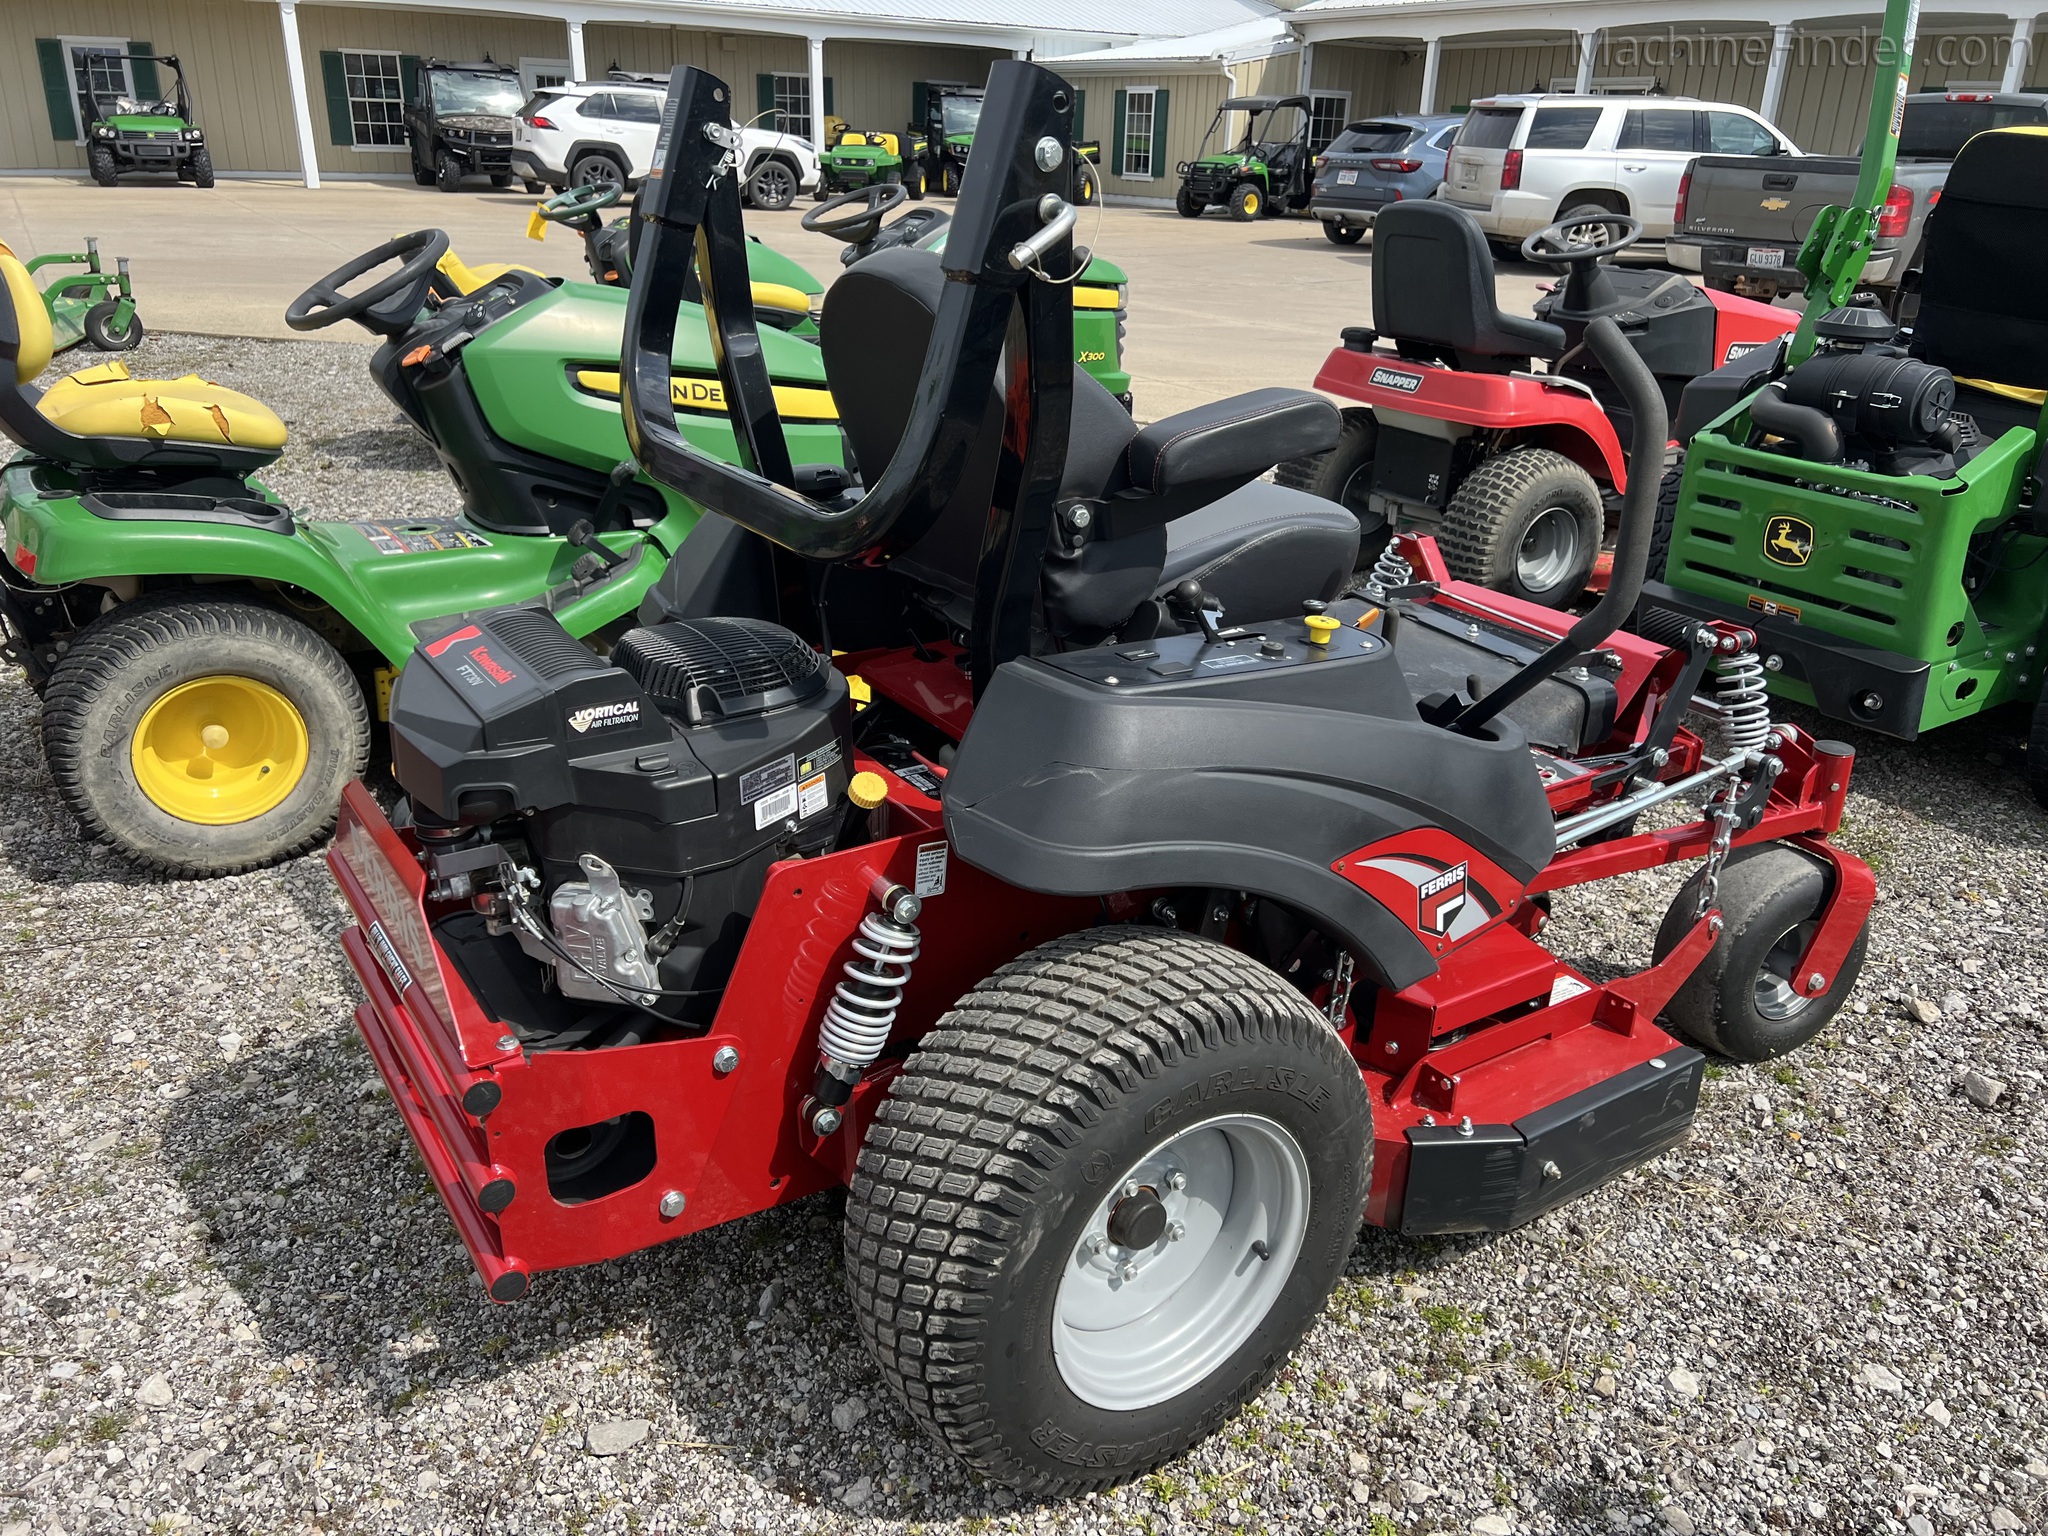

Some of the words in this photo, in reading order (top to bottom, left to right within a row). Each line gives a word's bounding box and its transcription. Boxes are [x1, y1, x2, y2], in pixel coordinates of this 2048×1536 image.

[1689, 225, 1735, 234] SILVERADO
[1764, 254, 1782, 266] 9378
[1078, 351, 1105, 363] X300
[1373, 370, 1418, 390] SNAPPER
[456, 664, 484, 686] FT730V
[469, 645, 517, 685] Kawasaki
[101, 664, 171, 759] CARLISLE
[575, 701, 639, 722] VORTICAL
[591, 720, 602, 728] AIR
[603, 714, 639, 726] FILTRATION
[325, 748, 340, 788] TURF
[266, 789, 325, 842] MASTER
[349, 818, 425, 972] FERRIS
[1421, 866, 1465, 899] FERRIS
[1144, 1065, 1332, 1135] CARLISLE
[1186, 1351, 1281, 1440] TURF
[1030, 1419, 1182, 1468] MASTER
